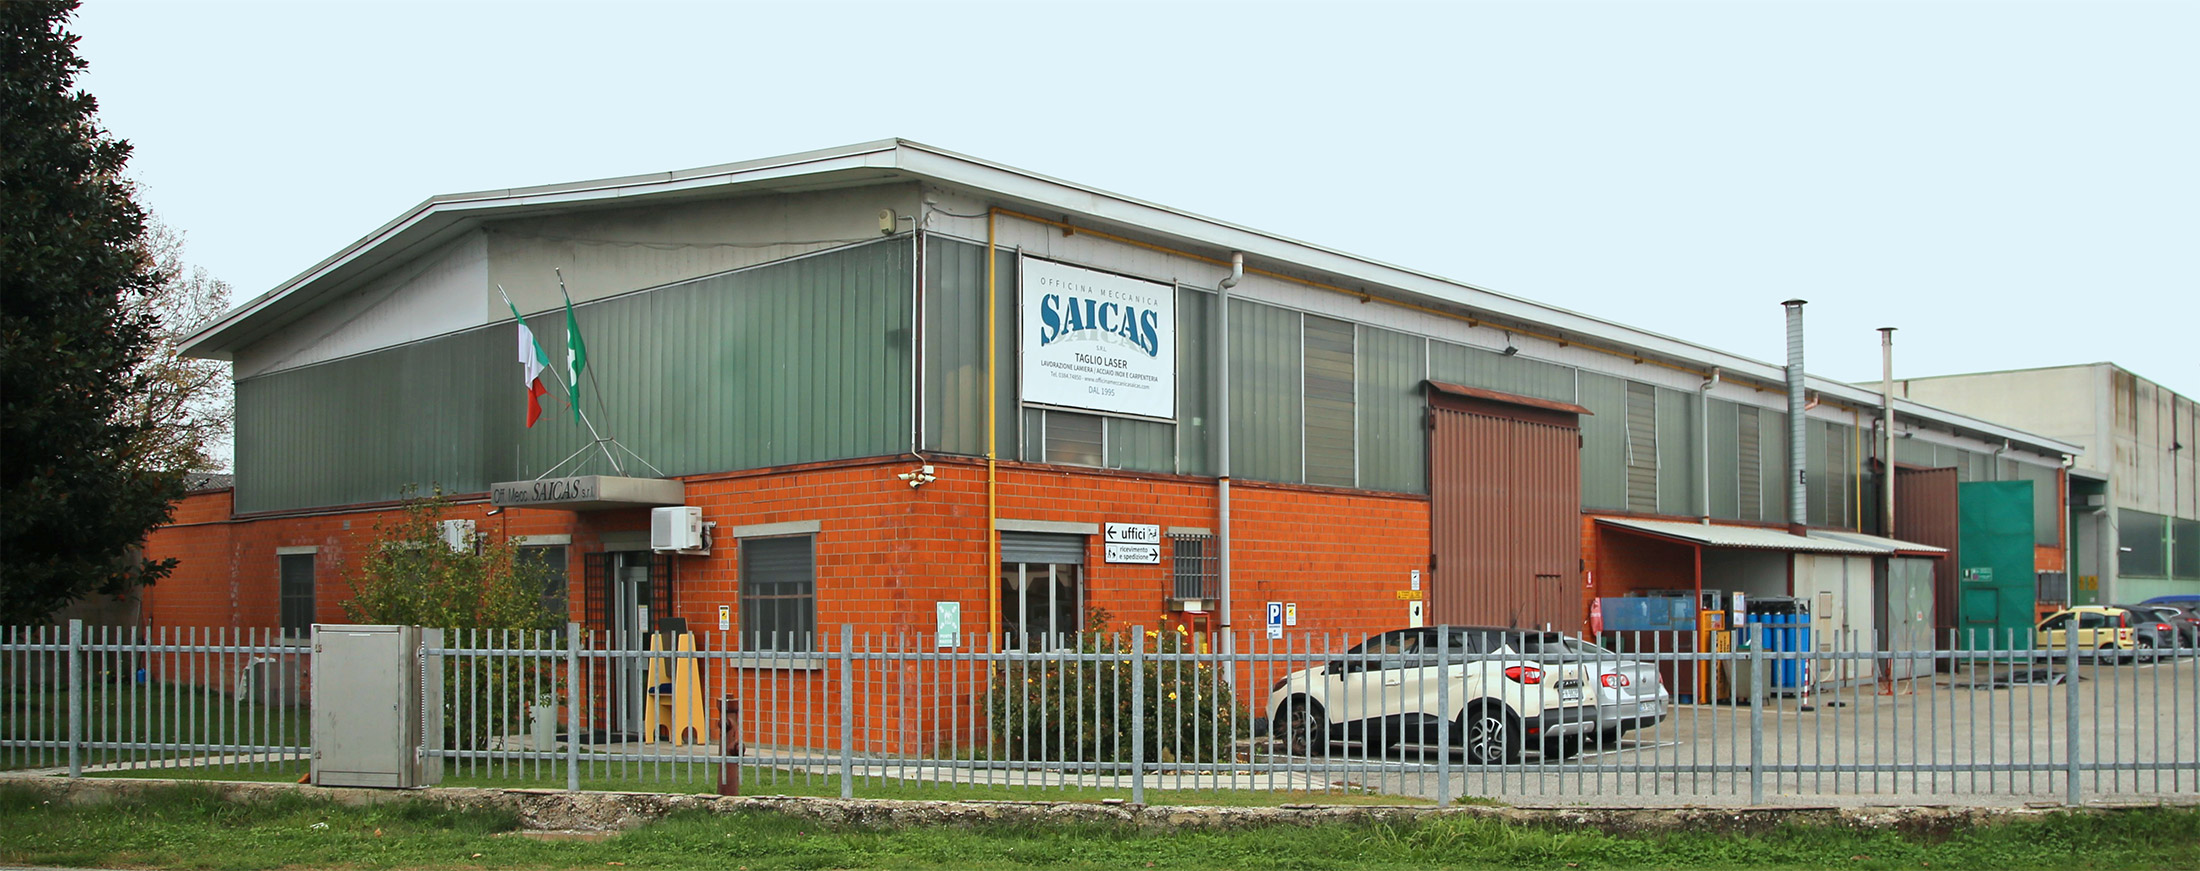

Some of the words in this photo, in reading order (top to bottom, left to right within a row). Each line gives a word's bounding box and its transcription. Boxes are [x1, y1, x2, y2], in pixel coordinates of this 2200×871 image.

[1040, 277, 1093, 294] OFFICINA
[1100, 289, 1158, 306] MECCANICA
[1040, 293, 1158, 357] SAICAS
[1040, 360, 1073, 371] LAVORAZIONE
[1073, 364, 1093, 374] LAMIERA
[1096, 368, 1115, 377] ACCIAIO
[1129, 373, 1158, 382] CARPENTERIA
[1075, 352, 1102, 366] TAGLIO
[1104, 357, 1127, 369] LASER
[1088, 386, 1100, 395] DAL
[1101, 388, 1115, 396] 1995
[532, 479, 580, 501] SAICAS
[1122, 527, 1146, 540] uffici
[1270, 604, 1280, 624] P
